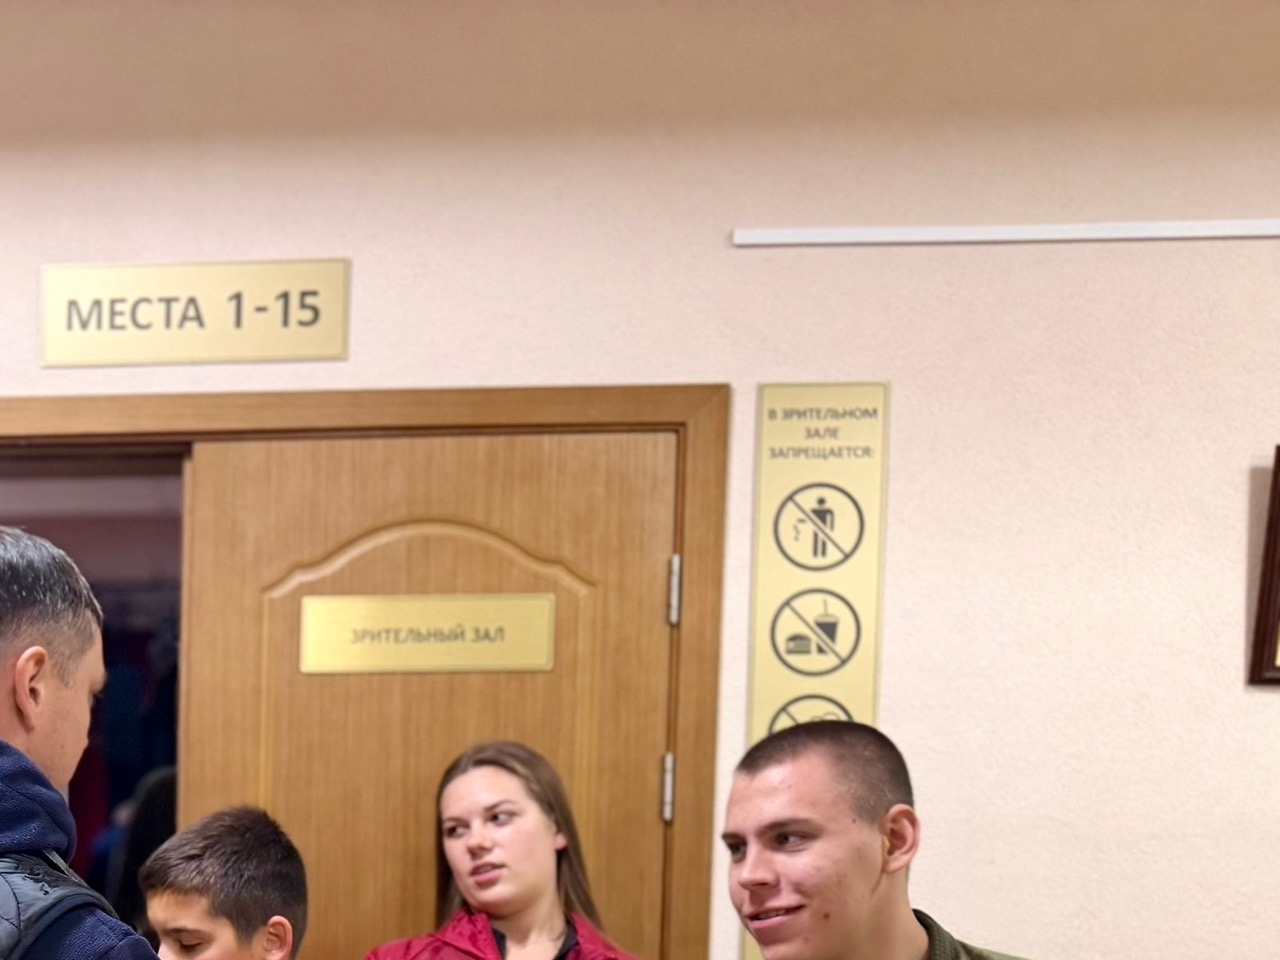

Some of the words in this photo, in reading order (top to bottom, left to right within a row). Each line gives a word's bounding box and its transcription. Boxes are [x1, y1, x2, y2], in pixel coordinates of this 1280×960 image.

[66, 295, 206, 331] МЕСТА
[227, 290, 322, 330] 1-15
[768, 408, 778, 421] В
[782, 408, 878, 421] ЗРИТЕЛЬНОМ
[805, 427, 839, 440] ЗАЛЕ
[350, 624, 466, 645] ЗРИТЕЛЬНЫЙ
[471, 625, 506, 644] ЗАЛ
